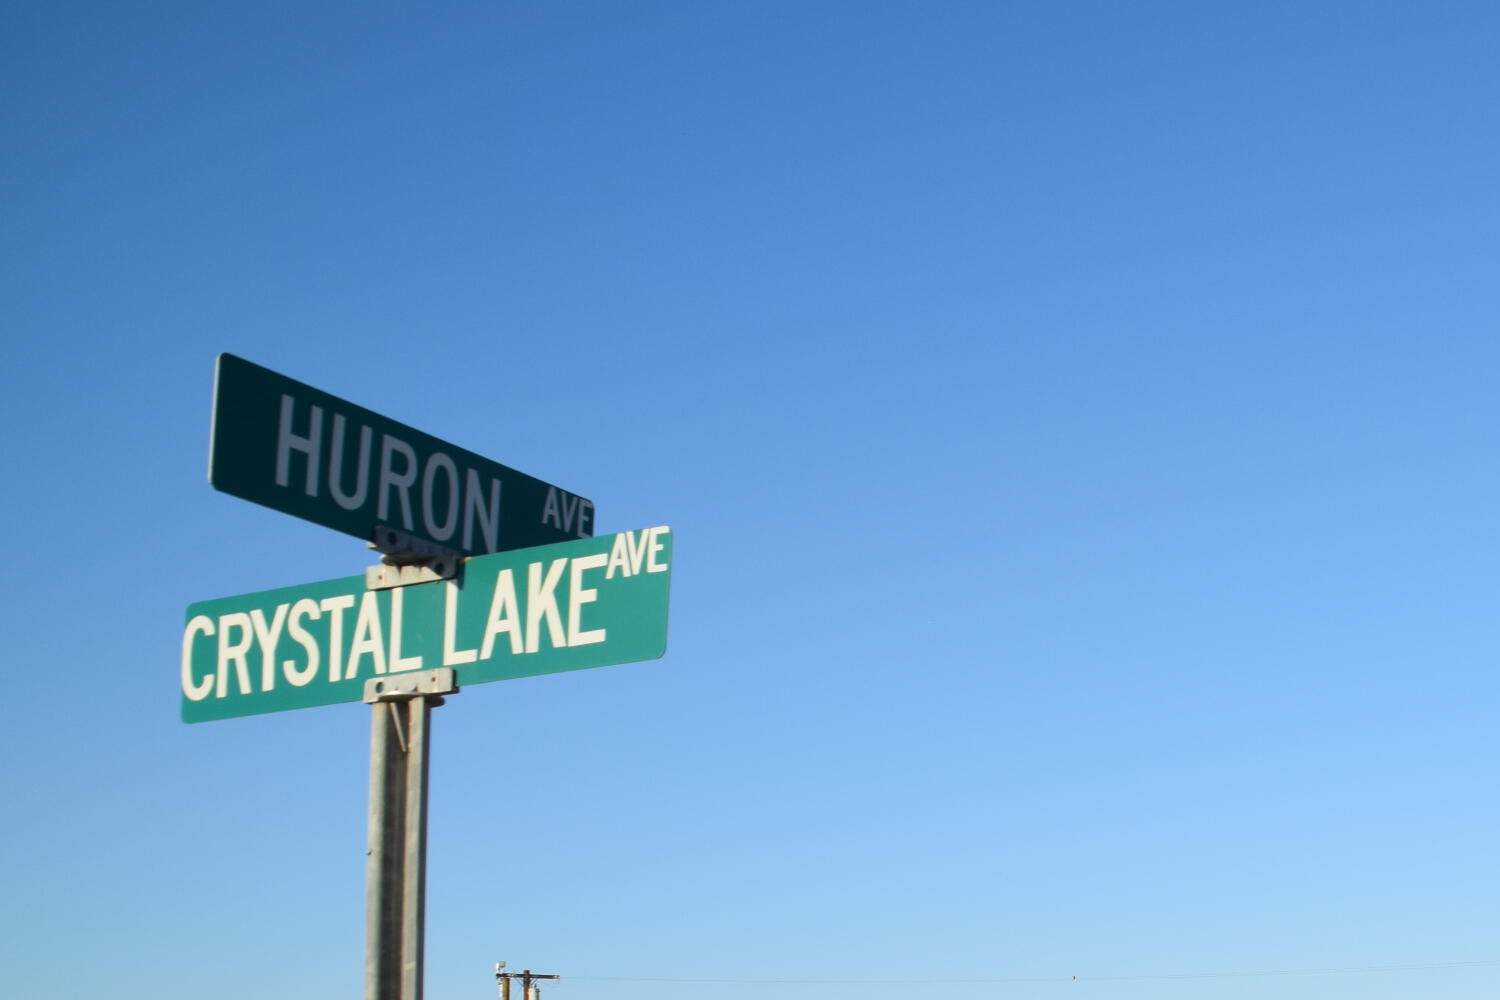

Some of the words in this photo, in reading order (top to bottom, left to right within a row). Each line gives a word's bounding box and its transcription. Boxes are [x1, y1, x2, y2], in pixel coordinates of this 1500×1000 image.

[276, 394, 500, 554] HURON
[542, 486, 594, 538] AVE
[181, 586, 423, 702] CRYSTAL
[443, 553, 608, 667] LAKE
[606, 526, 670, 580] AVE
